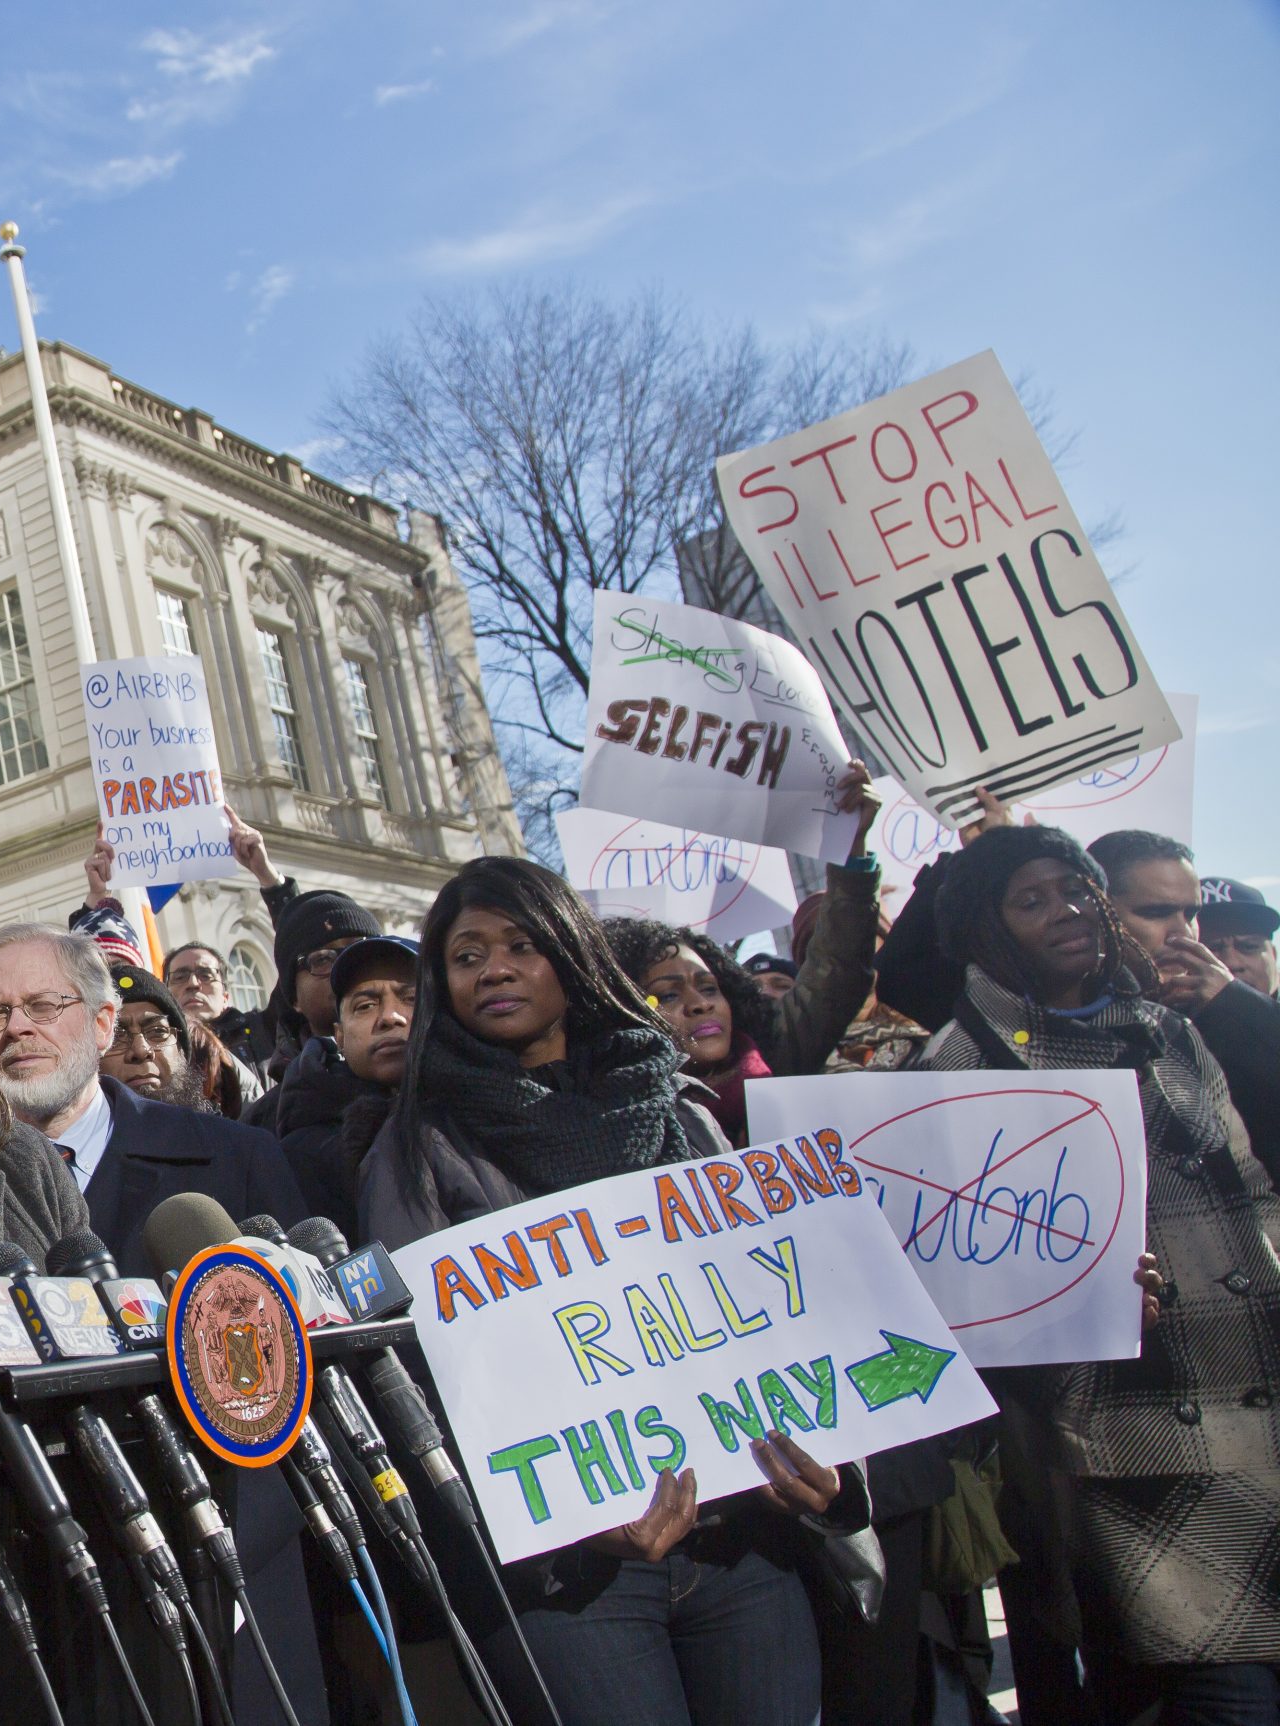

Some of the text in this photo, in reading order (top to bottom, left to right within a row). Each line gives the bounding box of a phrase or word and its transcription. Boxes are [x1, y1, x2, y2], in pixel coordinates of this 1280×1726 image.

[739, 390, 979, 534] STOP
[808, 528, 1139, 782] HOTELS
[92, 717, 213, 750] Your business
[122, 755, 135, 773] a
[106, 821, 171, 845] on my
[343, 1255, 371, 1284] NY
[66, 1281, 112, 1327] 2
[554, 1235, 806, 1387] RALLY
[53, 1325, 121, 1349] NEWS
[241, 1405, 265, 1421] 1625
[487, 1354, 839, 1525] THIS WAY
